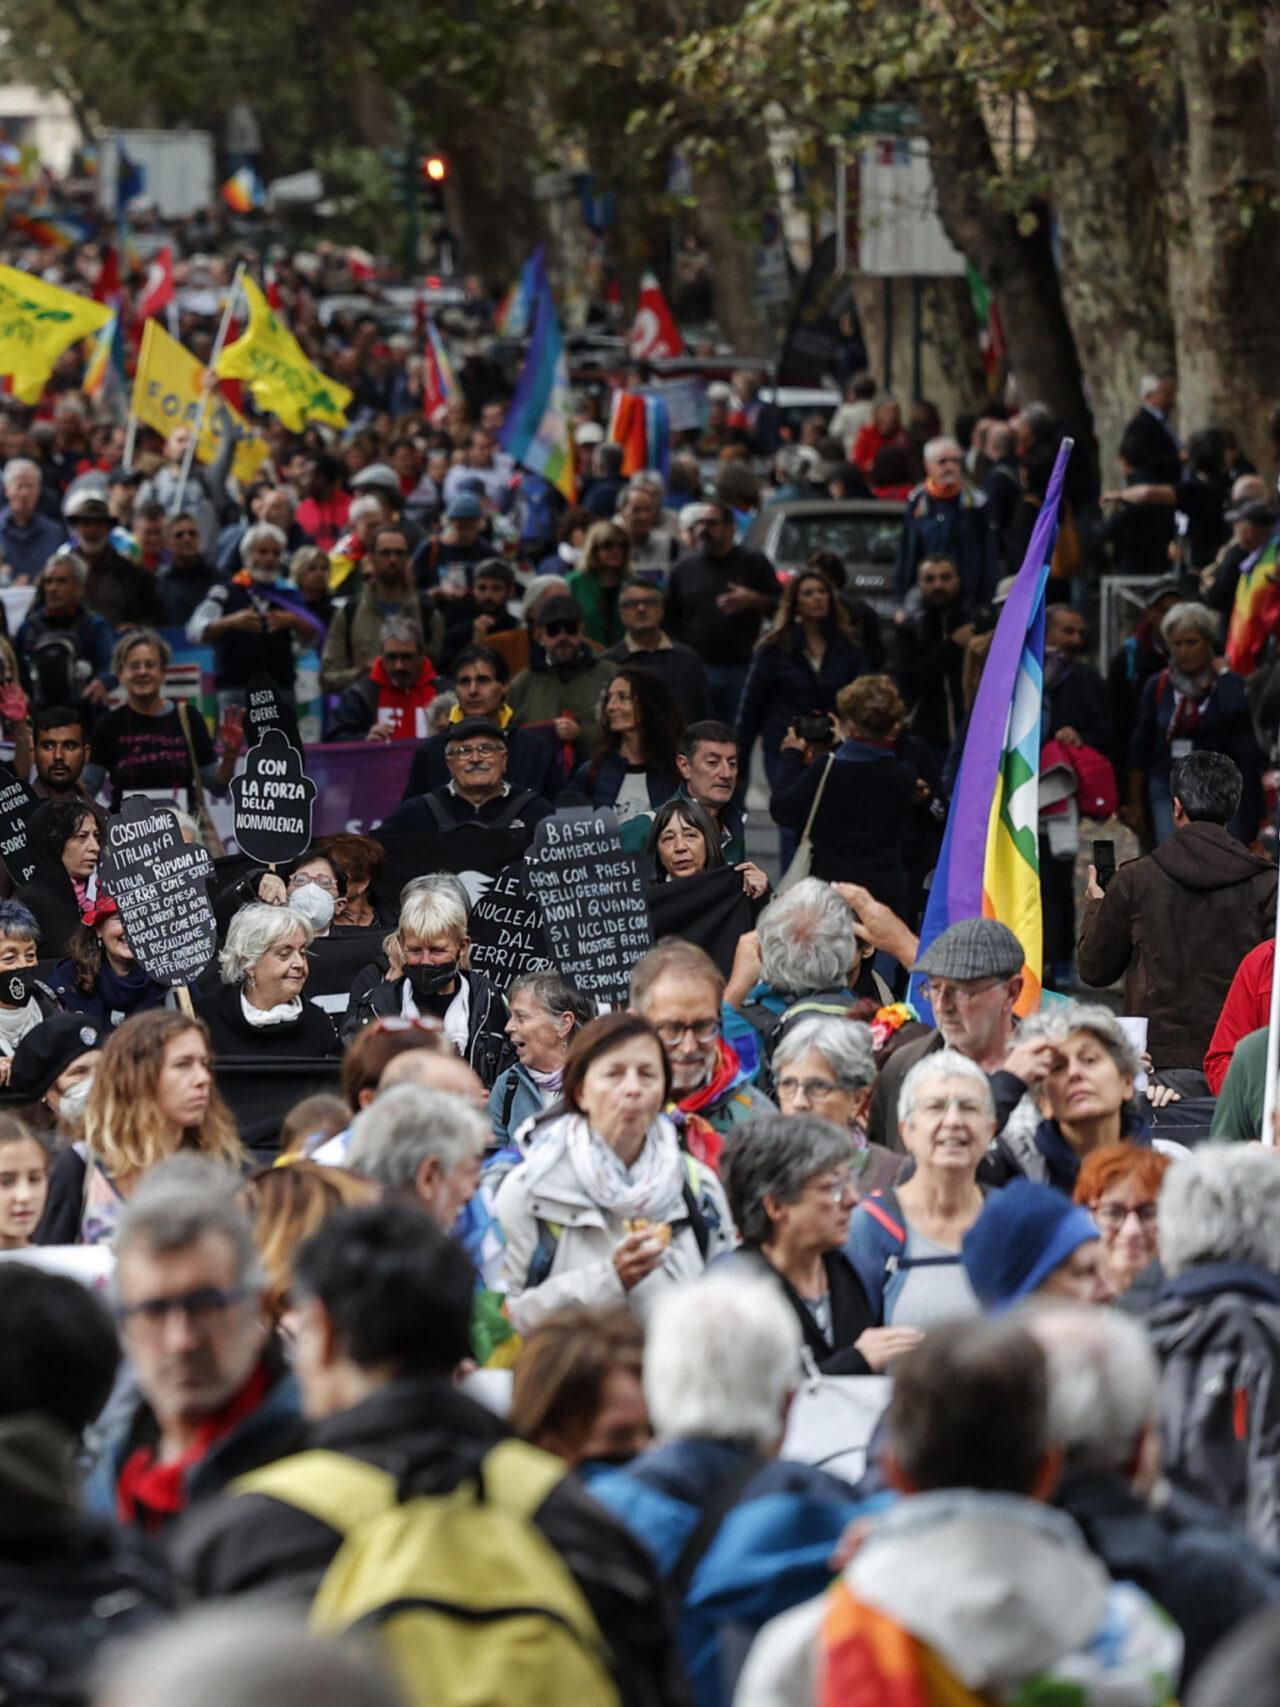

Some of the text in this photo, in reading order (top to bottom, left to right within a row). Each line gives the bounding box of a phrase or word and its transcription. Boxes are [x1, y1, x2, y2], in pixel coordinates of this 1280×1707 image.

[249, 690, 274, 706] BASTA
[249, 705, 280, 723] GUERRE
[257, 758, 287, 776] CON
[241, 780, 305, 799] LA FORZA
[1, 793, 30, 814] GUERRA
[242, 797, 275, 811] DELLA
[10, 817, 26, 832] LA
[110, 813, 175, 846] COSTITUZIONE
[236, 813, 304, 834] NONVIOLENZA
[546, 819, 605, 845] BASTA
[113, 832, 174, 870] ITALIANA
[152, 853, 194, 880] RIPUDIA
[195, 848, 208, 862] LA
[529, 860, 636, 888] ARMI CON PAESI
[117, 884, 158, 908] GUERRA
[161, 873, 186, 892] COME
[493, 876, 520, 896] LE
[538, 881, 628, 907] BELLIGERANTI
[632, 879, 641, 892] E
[123, 905, 148, 922] MENTO
[163, 887, 197, 907] OFFESA
[545, 897, 646, 923] NON! QUANDO
[126, 919, 146, 936] ALLA
[177, 904, 188, 916] DI
[550, 914, 648, 942] SI UCCIDE CON
[132, 927, 160, 946] POPOLI
[160, 925, 168, 937] E
[498, 928, 534, 950] DAL
[554, 932, 650, 959] LE NOSTRE ARMI
[135, 947, 147, 959] DI
[144, 953, 170, 971] DELLE
[469, 943, 557, 972] TERRITORI
[561, 959, 594, 975] ANCHE
[597, 953, 617, 969] NOI
